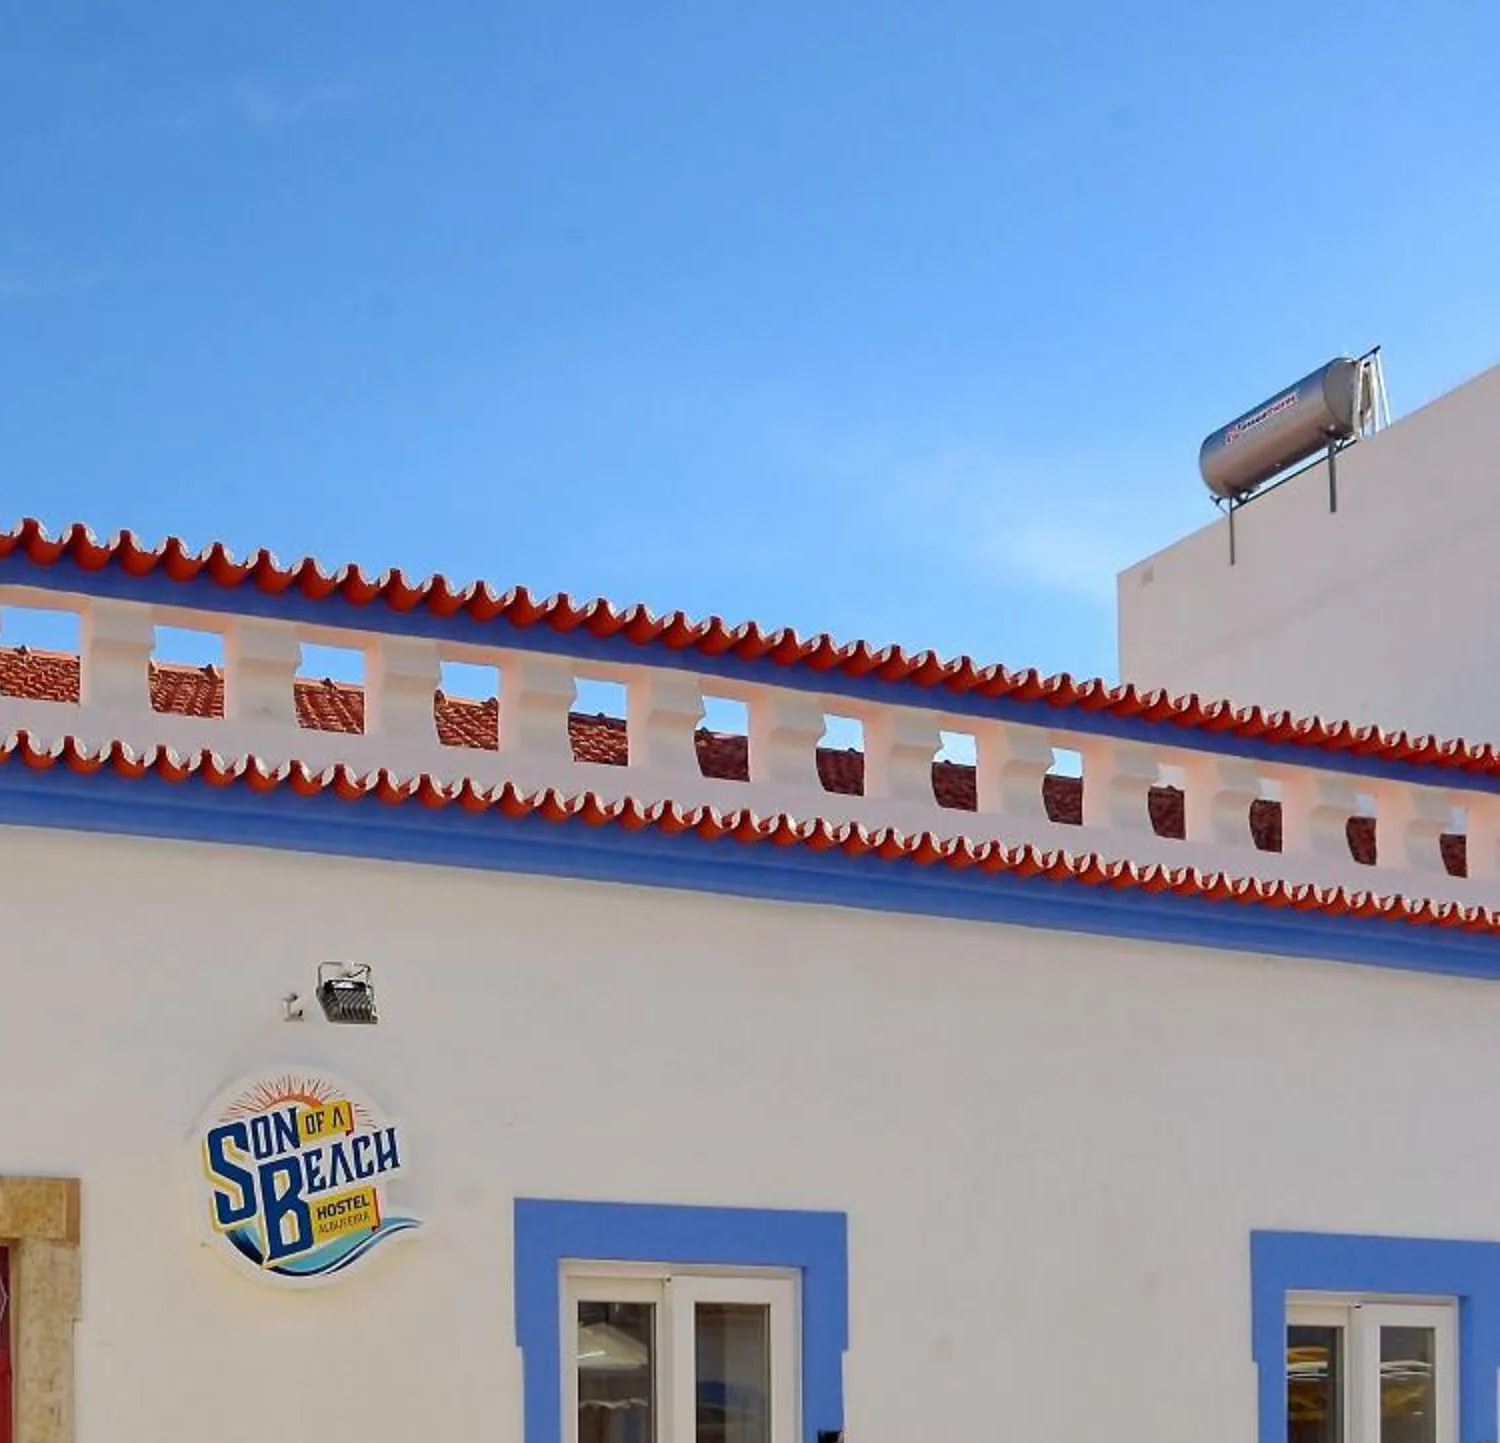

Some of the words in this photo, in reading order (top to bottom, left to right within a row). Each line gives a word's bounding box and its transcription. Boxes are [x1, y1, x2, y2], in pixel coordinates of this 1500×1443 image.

[207, 1106, 301, 1225] SON
[305, 1111, 325, 1135] OF
[332, 1106, 346, 1128] A
[258, 1127, 401, 1260] BEACH
[316, 1194, 370, 1219] HOSTEL
